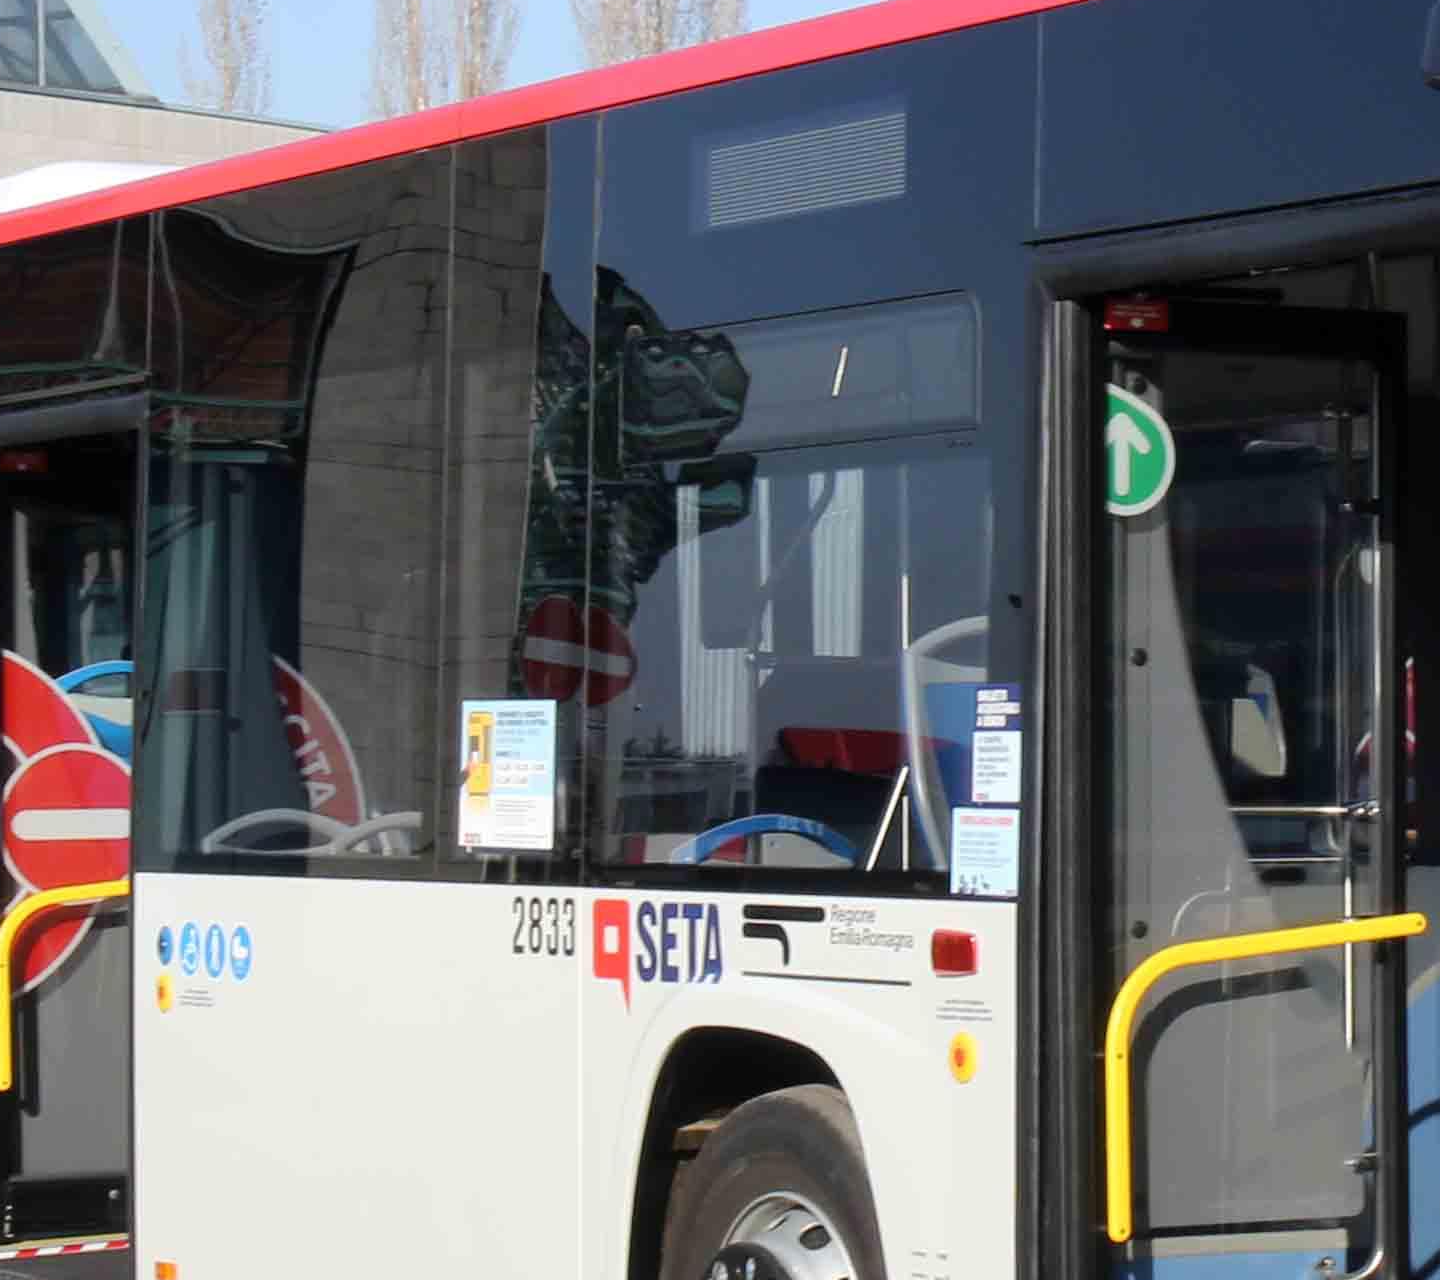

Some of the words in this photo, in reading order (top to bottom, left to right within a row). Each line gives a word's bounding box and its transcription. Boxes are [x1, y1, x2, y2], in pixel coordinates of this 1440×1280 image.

[512, 896, 575, 956] 2833
[636, 901, 723, 984] SETA
[831, 903, 876, 927] Regione
